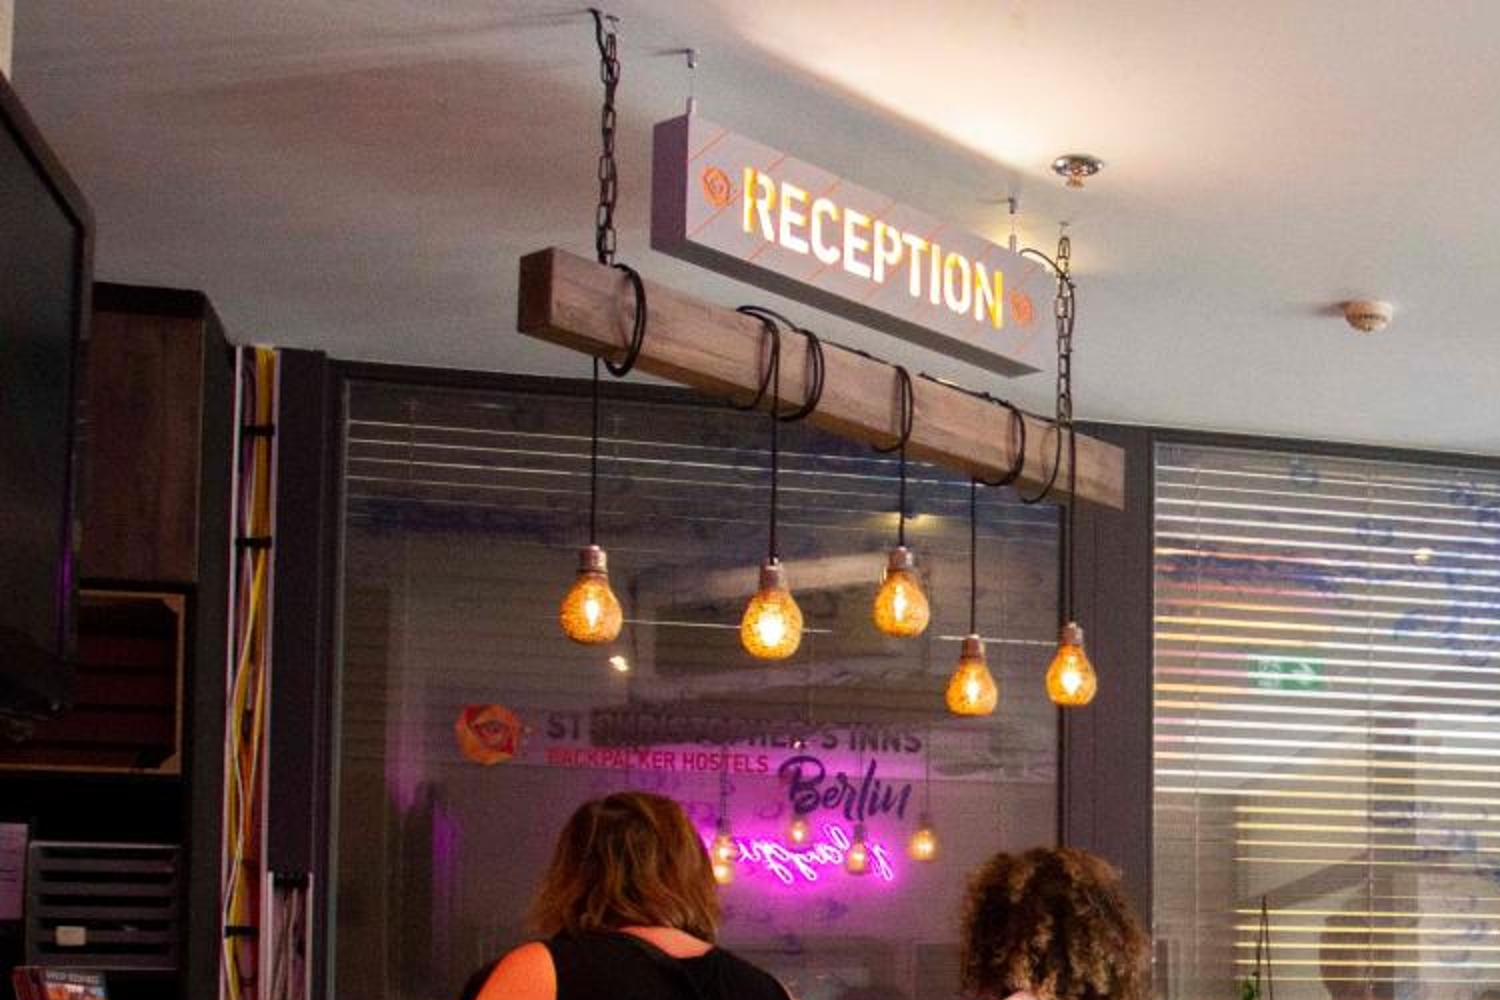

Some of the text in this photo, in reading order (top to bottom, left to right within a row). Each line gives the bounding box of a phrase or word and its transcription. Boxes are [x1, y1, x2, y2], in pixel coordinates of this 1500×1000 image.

[743, 167, 1004, 330] RECEPTION
[546, 711, 580, 741] ST
[850, 722, 922, 753] INNS
[545, 746, 770, 774] BACKPACKER HOSTELS
[778, 755, 912, 822] Berlin
